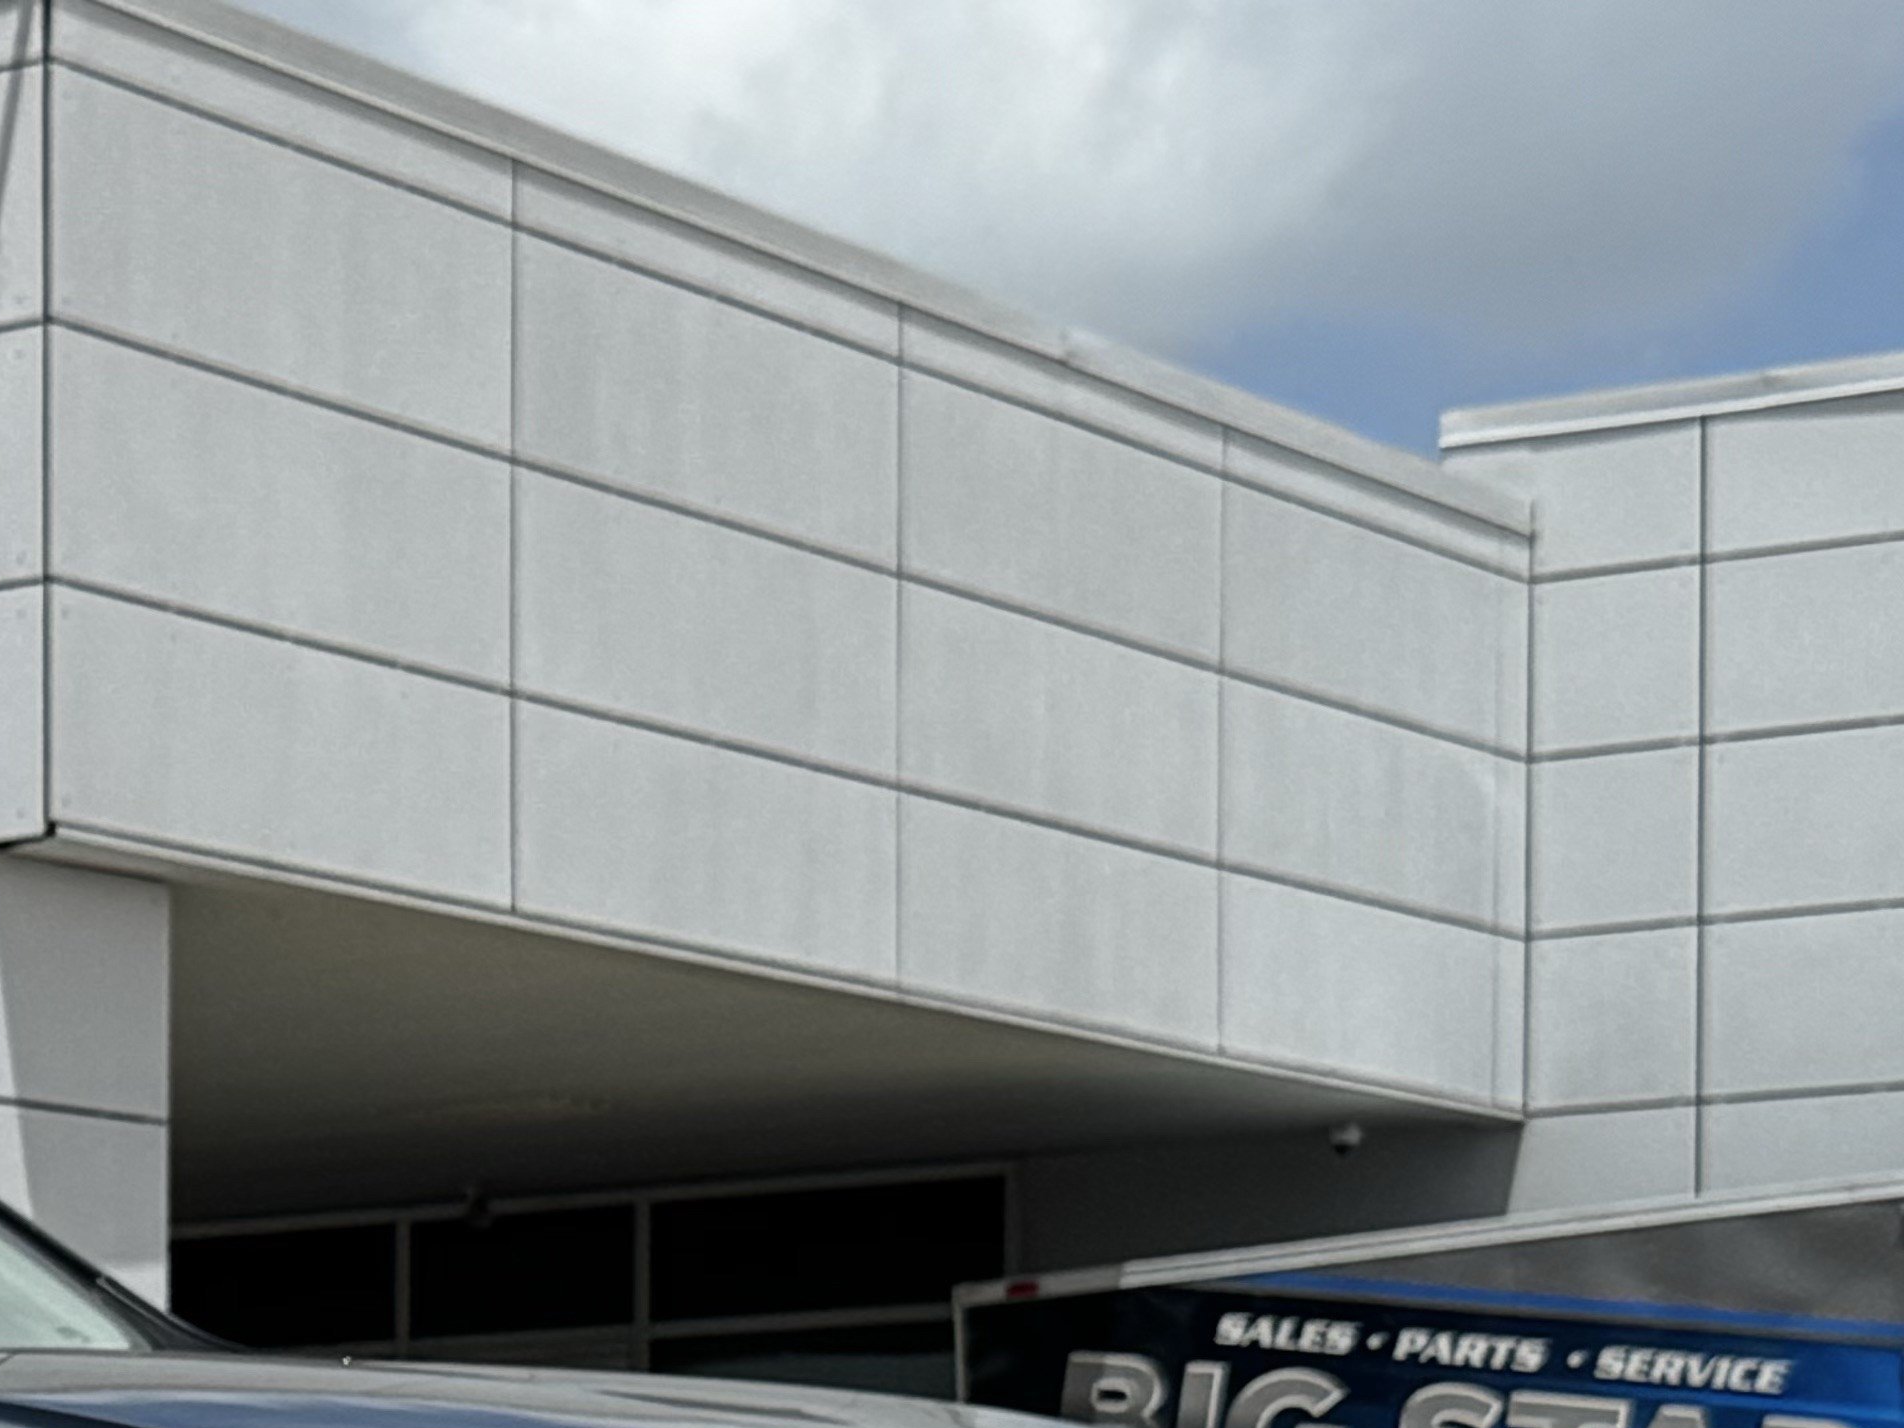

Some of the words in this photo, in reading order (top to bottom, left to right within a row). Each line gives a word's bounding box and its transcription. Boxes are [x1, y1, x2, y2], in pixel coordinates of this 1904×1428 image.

[1215, 1311, 1358, 1356] SALES
[1393, 1328, 1550, 1373] PARTS
[1594, 1346, 1793, 1396] SERVICE
